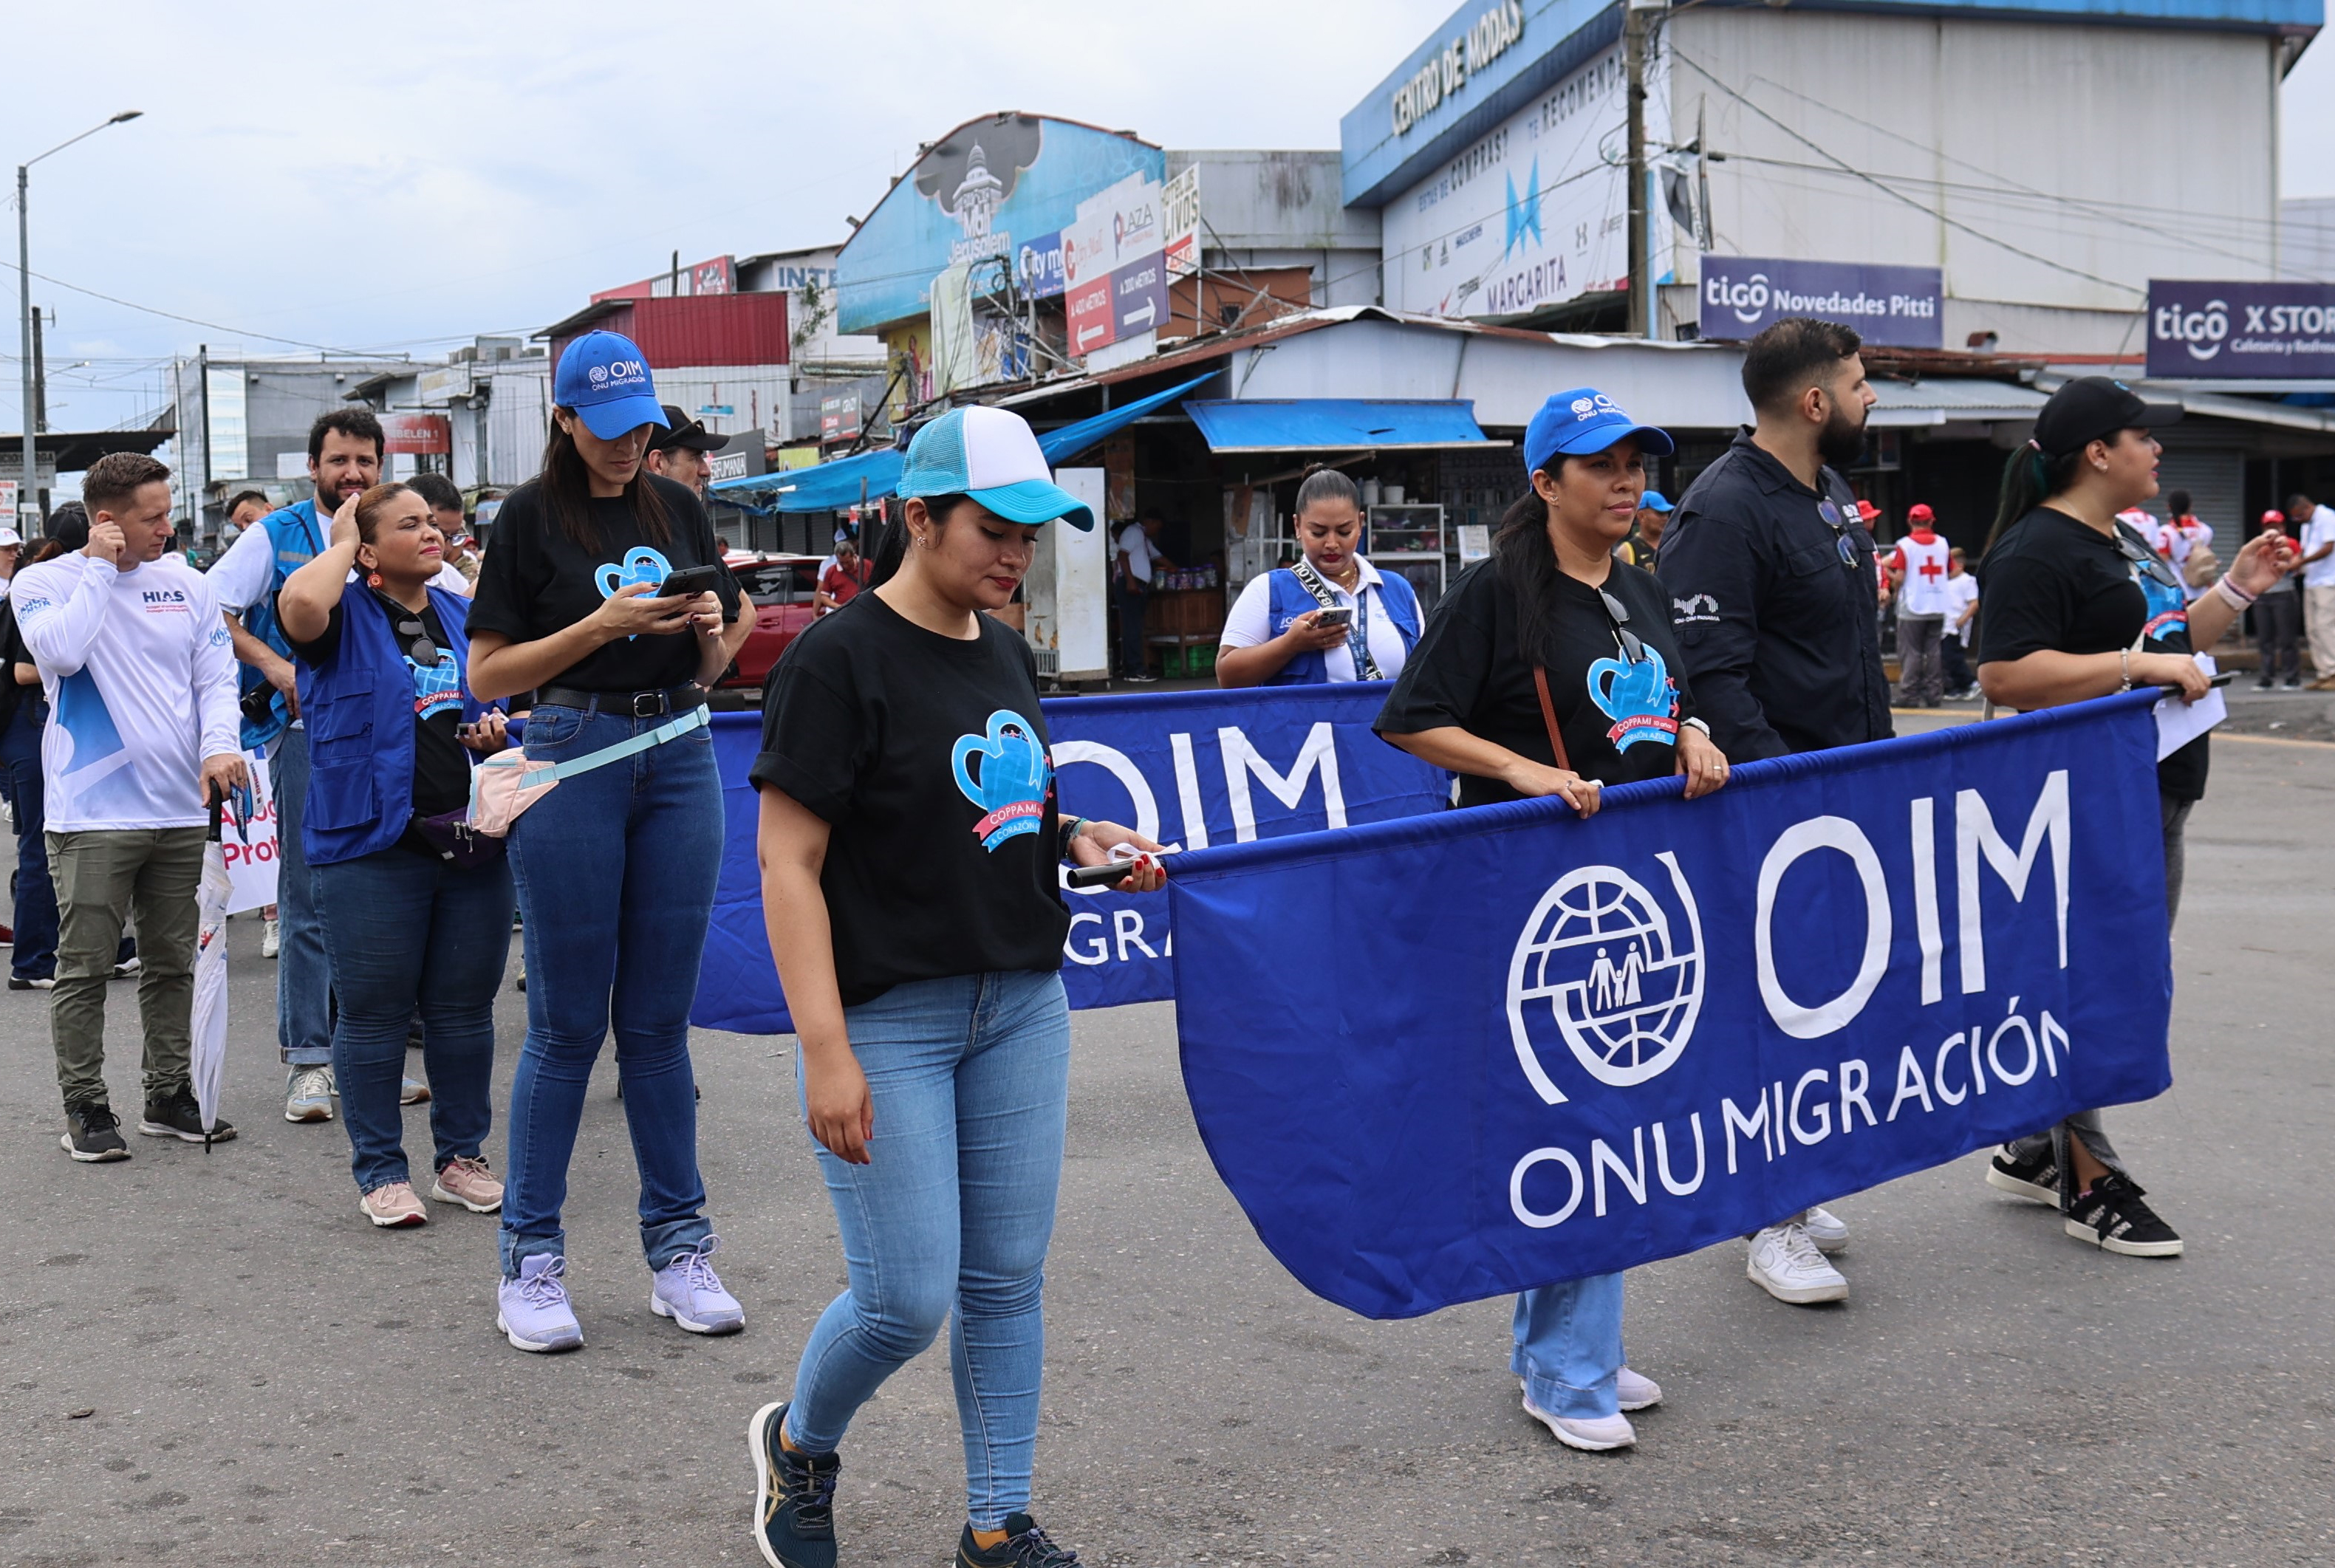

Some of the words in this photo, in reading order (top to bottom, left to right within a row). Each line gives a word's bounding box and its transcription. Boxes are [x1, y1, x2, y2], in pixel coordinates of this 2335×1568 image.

[1392, 59, 1440, 136] CENTRO
[1443, 36, 1464, 96] DE
[1466, 0, 1523, 75] MODAS
[963, 201, 991, 241] Mall
[948, 230, 1011, 264] Jerusalem
[1488, 254, 1567, 315] MARGARITA
[1706, 274, 1769, 323] tigo
[1774, 289, 1886, 315] Novedades
[1890, 295, 1935, 318] Pitti
[2154, 301, 2229, 360] tigo
[2244, 305, 2266, 333] X
[592, 382, 609, 391] ONU
[610, 374, 646, 386] MIGRACIÓN
[610, 360, 643, 377] OIM
[1577, 409, 1598, 422] ONU
[143, 590, 185, 603] HIAS
[422, 691, 459, 706] COPPAMI
[1617, 716, 1652, 733] COPPAMI
[1049, 721, 1348, 895] OIM
[996, 820, 1034, 841] CORAZÓN
[1756, 770, 2068, 1040] OIM
[1509, 1112, 1706, 1228] ONU
[1722, 996, 2069, 1174] MIGRACIÓN
